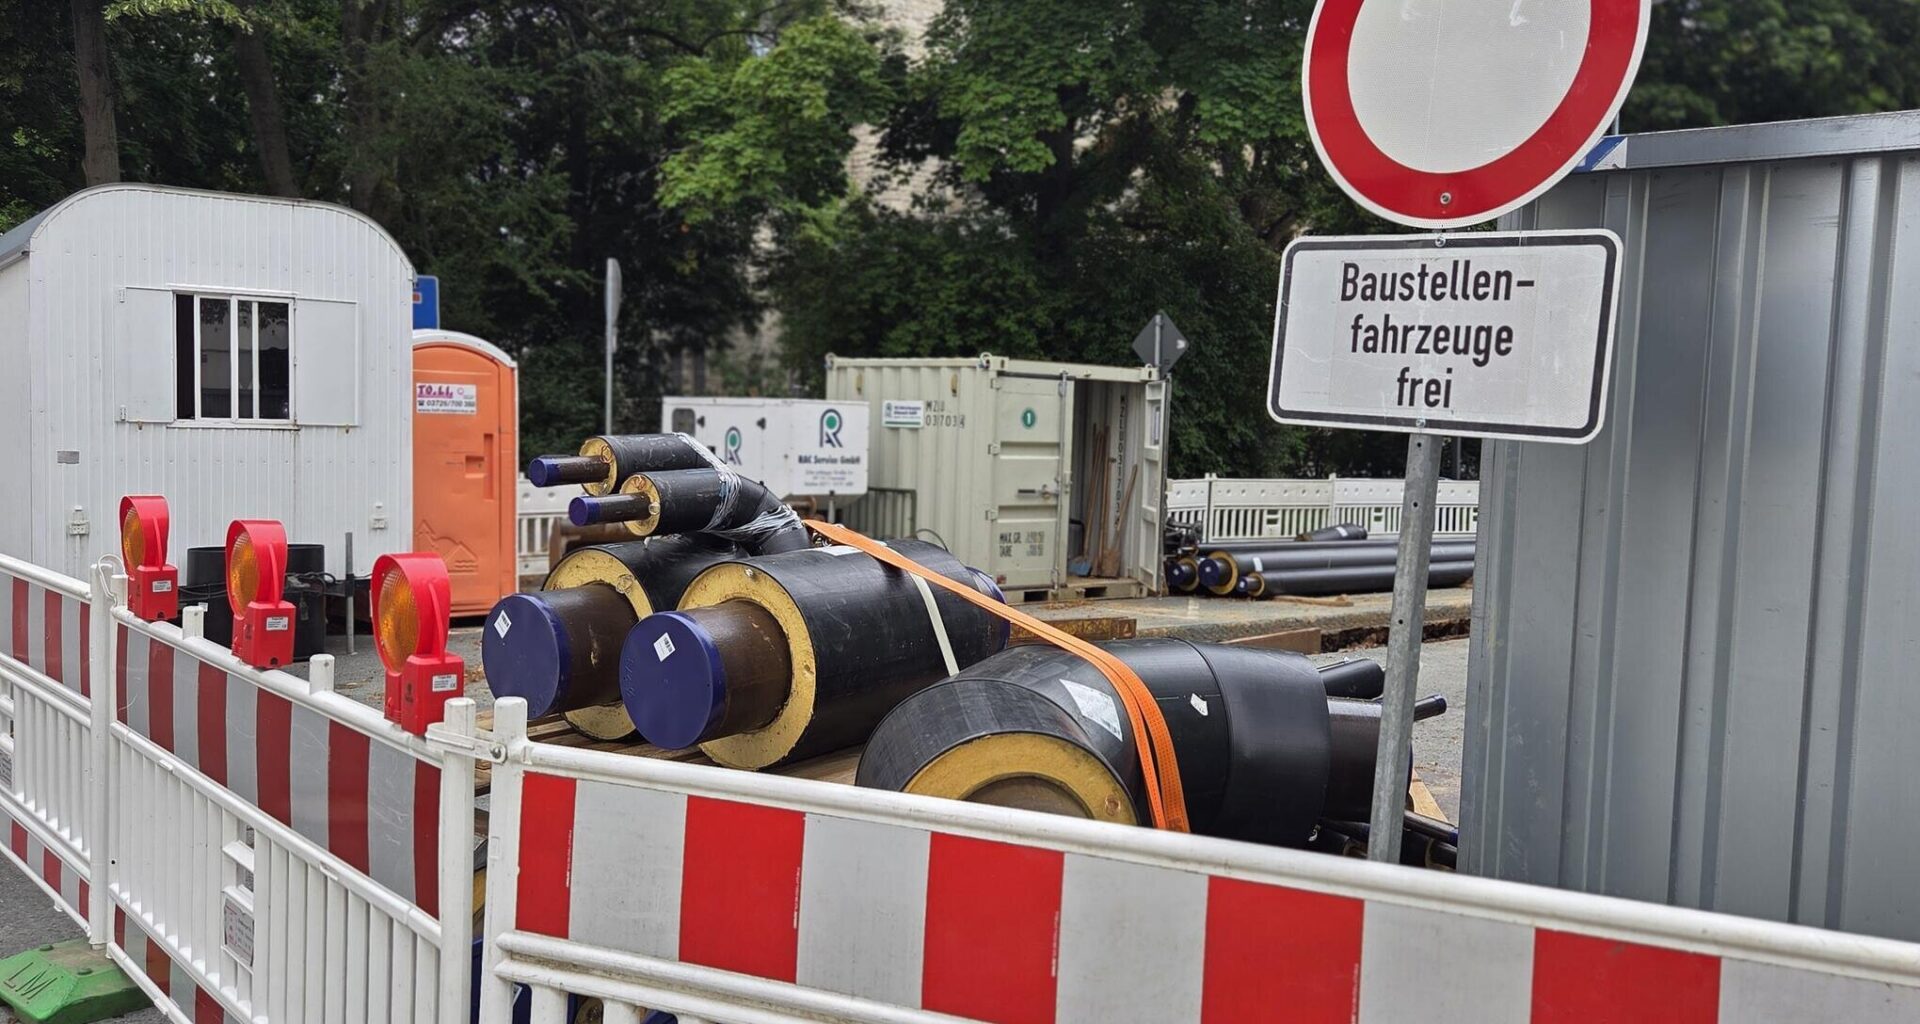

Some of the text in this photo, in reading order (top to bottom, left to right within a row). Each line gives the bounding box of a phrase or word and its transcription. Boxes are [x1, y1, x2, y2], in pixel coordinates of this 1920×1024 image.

[1340, 259, 1536, 303] Baustellen-
[1350, 313, 1514, 369] fahrzeuge
[1396, 366, 1454, 409] frei
[840, 455, 861, 465] GmbH
